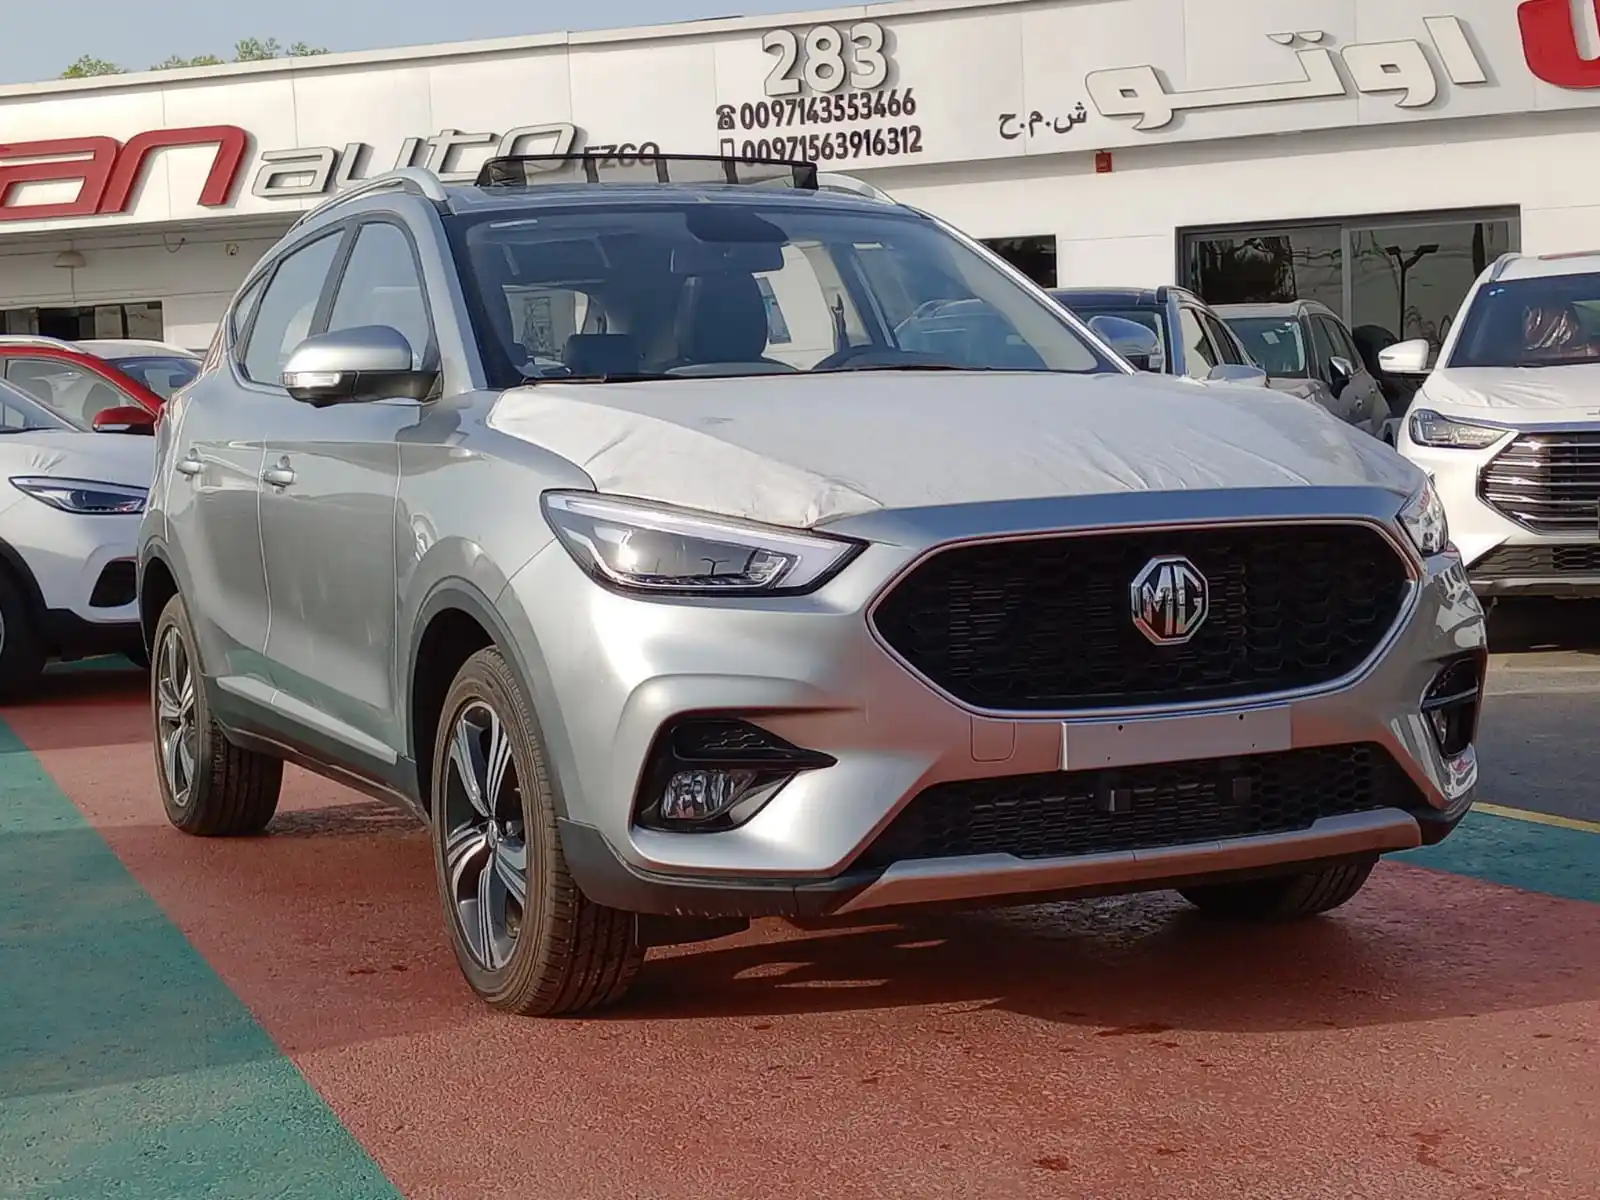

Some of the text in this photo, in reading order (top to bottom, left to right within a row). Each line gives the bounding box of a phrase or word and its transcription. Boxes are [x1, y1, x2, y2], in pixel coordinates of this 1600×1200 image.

[762, 22, 888, 96] 283
[740, 88, 917, 130] 0097143553466
[741, 125, 924, 166] 00971563916312
[251, 122, 576, 198] auto
[1140, 563, 1204, 637] MG
